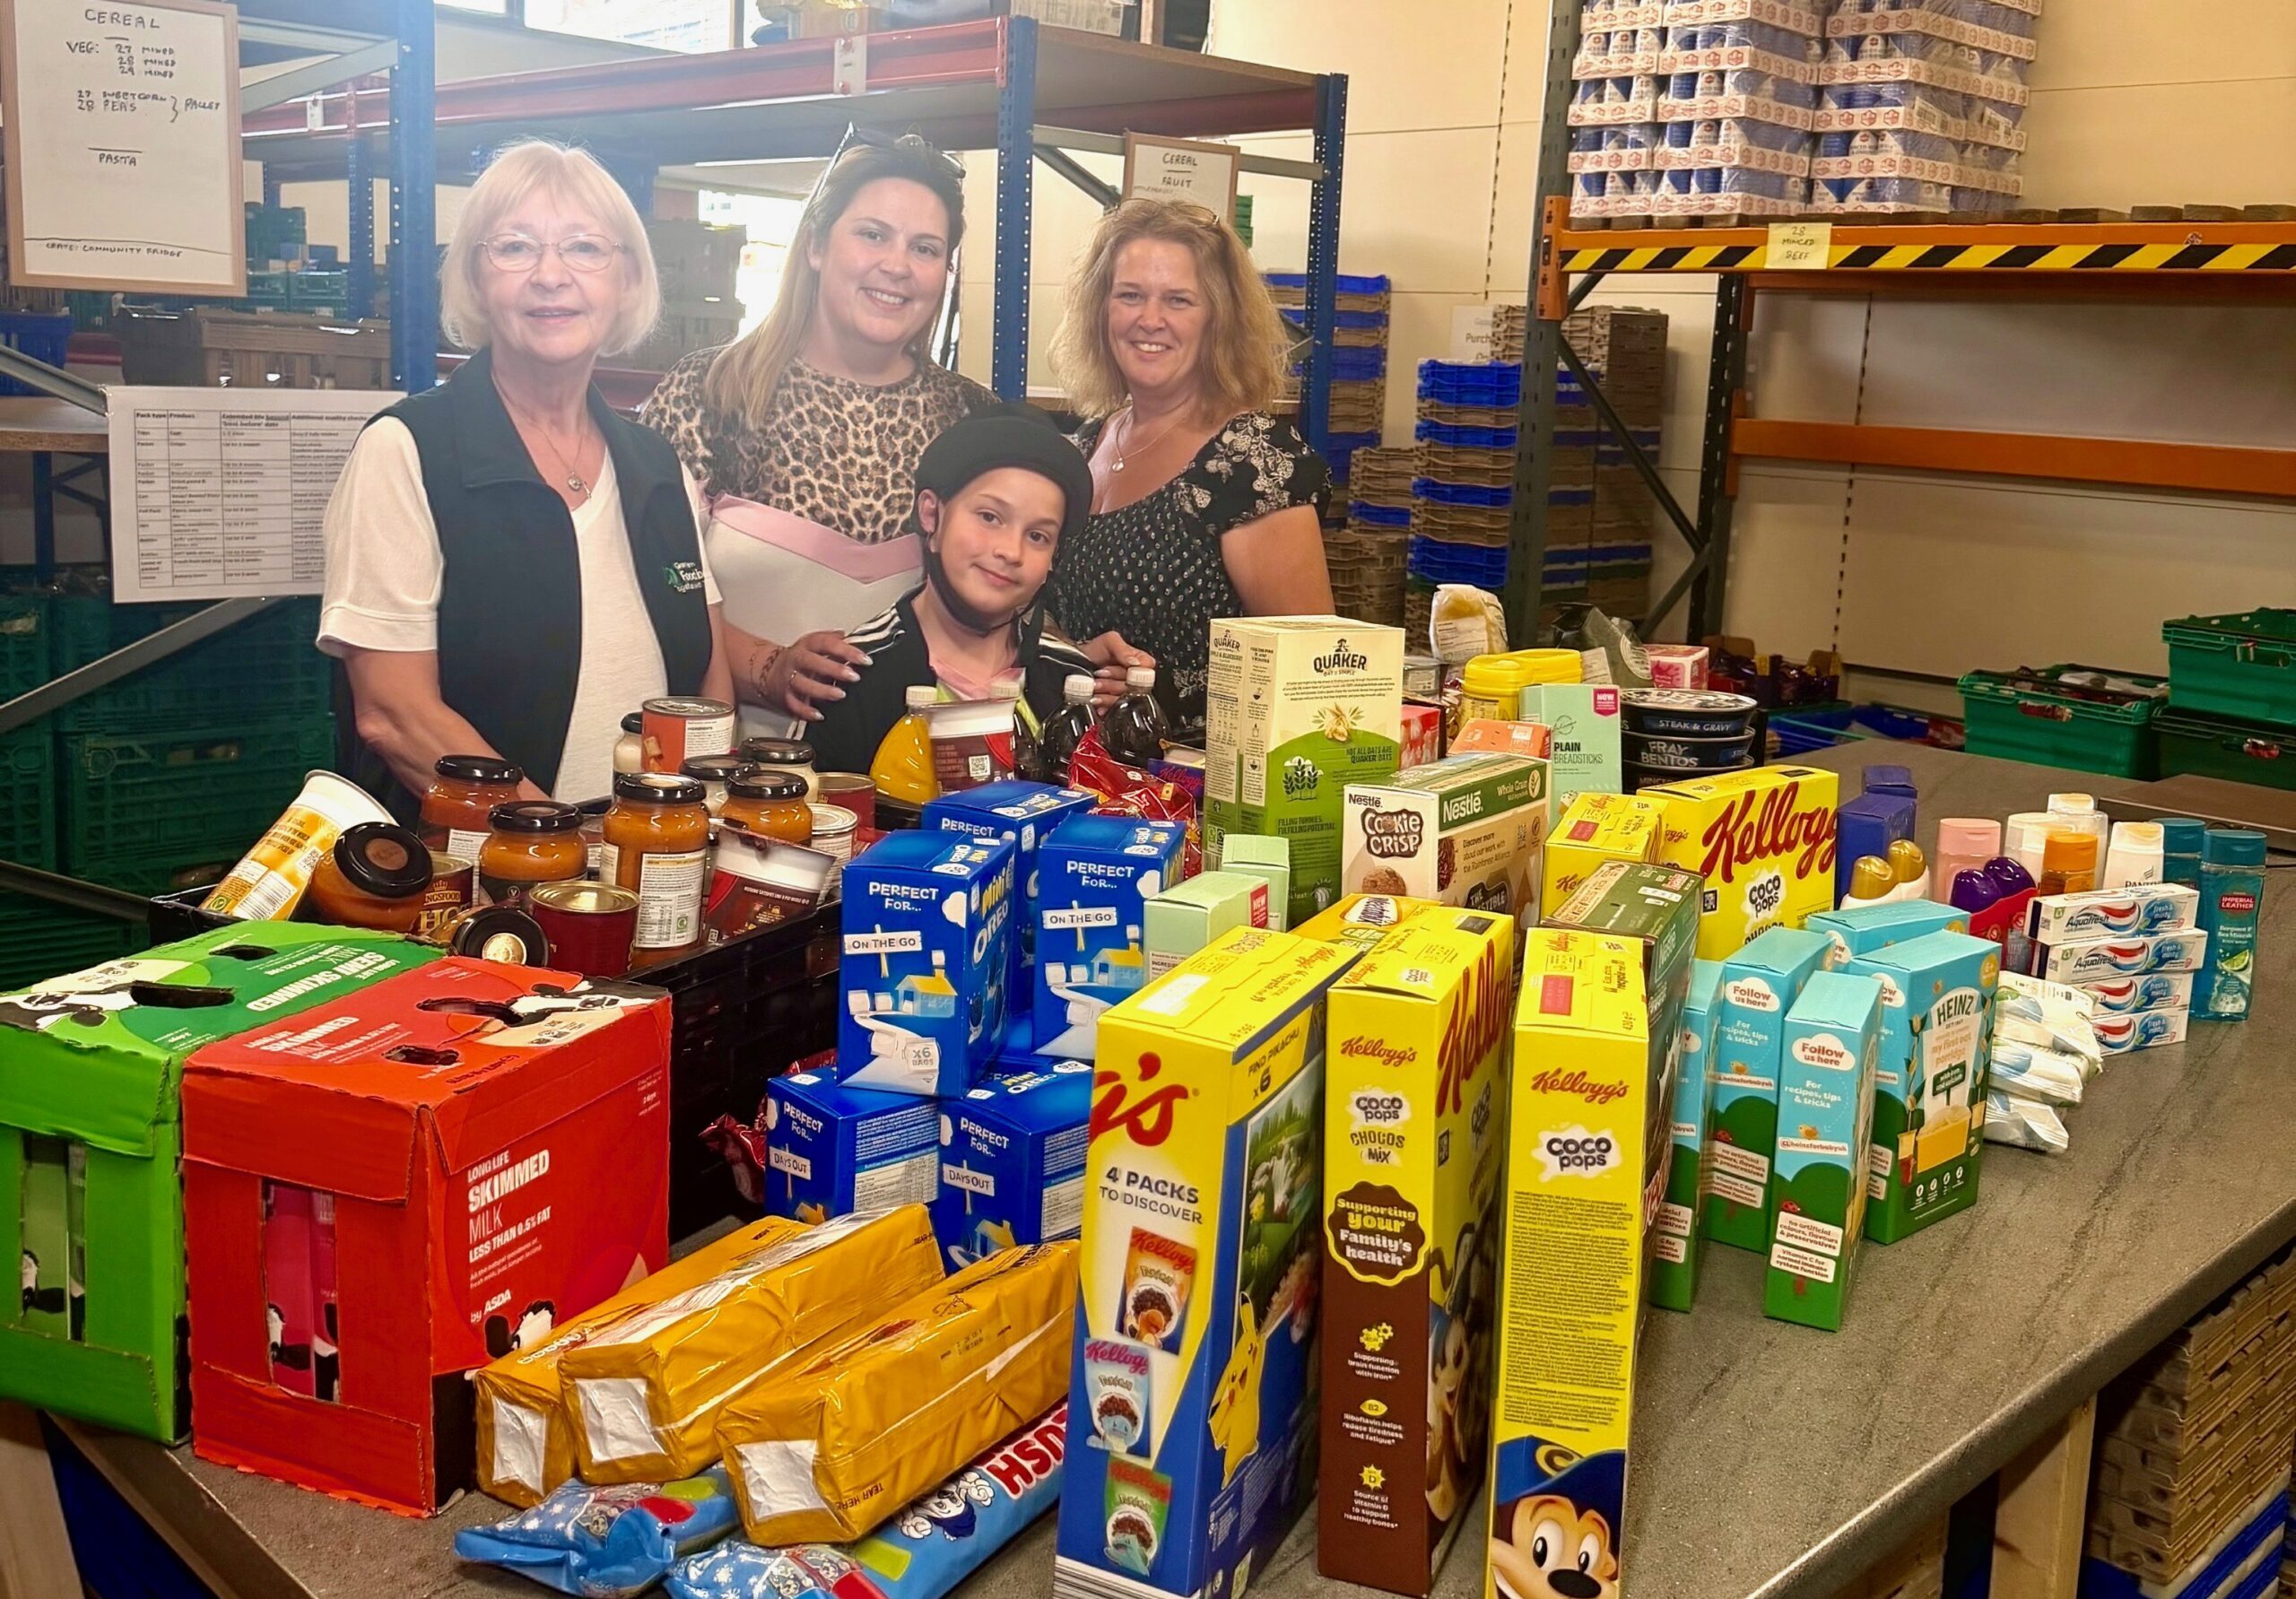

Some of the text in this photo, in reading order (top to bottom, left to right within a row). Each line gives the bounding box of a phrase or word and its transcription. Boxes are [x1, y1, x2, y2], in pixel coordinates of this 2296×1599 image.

[85, 9, 160, 29] CEREAL
[66, 41, 100, 54] VEG:
[115, 44, 132, 54] 27
[117, 56, 135, 65] 28
[77, 100, 94, 111] 28
[103, 100, 136, 111] PEAS
[99, 153, 136, 167] PASTA
[1162, 152, 1198, 167] CEREAL
[1161, 177, 1193, 187] FRUIT
[1791, 226, 1805, 236] 28
[83, 245, 142, 254] COMMUNITY
[1781, 238, 1814, 246] MINCED
[1786, 250, 1810, 260] BEEF
[1213, 638, 1241, 652] QUAKER
[1313, 653, 1368, 673] QUAKER
[1658, 719, 1732, 732] STEAK GRAVY
[1553, 742, 1581, 752] PLAIN
[1648, 741, 1689, 756] FRAY
[1351, 754, 1377, 764] QUAKER
[1553, 752, 1604, 765] BREADSTICKS
[1640, 752, 1700, 767] BENTOS
[1497, 783, 1514, 797] Whole
[941, 817, 995, 839] PERFECT
[1463, 832, 1495, 848] Discover more
[1066, 860, 1135, 879] PERFECT
[868, 881, 940, 900] PERFECT
[1252, 894, 1266, 910] NEW
[2222, 896, 2254, 904] IMPERIAL
[2222, 902, 2254, 910] LEATHER
[2152, 904, 2168, 913] fresh
[2153, 911, 2170, 920] minty
[1049, 912, 1112, 925] ON THE GO
[2066, 915, 2109, 929] Aquafresh
[973, 901, 1009, 963] OREO
[852, 936, 916, 950] ON THE GO
[2161, 945, 2176, 954] fresh
[2074, 953, 2118, 969] Aquafresh
[2161, 952, 2179, 960] minty
[246, 952, 386, 1012] SEMI SKIMMED
[1733, 986, 1770, 1001] Follow
[1735, 995, 1767, 1008] us here
[1936, 994, 1975, 1026] HEINZ
[1736, 1020, 1751, 1028] For
[258, 1016, 361, 1052] SKIMMED
[1735, 1036, 1758, 1047] tricks
[1752, 1030, 1768, 1041] tips
[1943, 1036, 1959, 1048] first
[911, 1047, 931, 1058] x6
[1248, 1028, 1300, 1077] FIND PIKACHU
[1340, 1036, 1418, 1067] Kellogg's
[1802, 1042, 1844, 1058] Follow
[1935, 1047, 1967, 1068] porridge
[912, 1057, 935, 1066] BAGS
[1804, 1054, 1840, 1066] us here
[1006, 1073, 1057, 1095] OREO
[1531, 1067, 1629, 1105] Kellogg's
[1805, 1080, 1822, 1090] For
[1785, 1086, 1841, 1102] recipes, tips
[1803, 1096, 1831, 1108] tricks
[783, 1100, 823, 1134] PERFECT
[960, 1117, 1010, 1150] PERFECT
[1350, 1130, 1405, 1148] CHOCOS
[467, 1150, 509, 1184] LONG LIFE
[793, 1159, 807, 1173] OUT
[468, 1148, 550, 1213] SKIMMED
[971, 1176, 991, 1191] OUT
[1106, 1167, 1199, 1204] 4 PACKS
[1099, 1186, 1204, 1225] TO DISCOVER
[1336, 1198, 1416, 1221] Supporting
[469, 1202, 503, 1245] MILK
[1347, 1212, 1405, 1233] your
[1799, 1221, 1831, 1236] artificial
[469, 1205, 552, 1264] LESS THAN 0.5% FAT
[1340, 1229, 1412, 1252] Family's
[1786, 1231, 1837, 1250] preservatives
[1808, 1230, 1839, 1244] flavours
[1777, 1255, 1799, 1266] normal
[1782, 1249, 1808, 1261] Vitamin
[1776, 1259, 1829, 1279] system function
[470, 1289, 512, 1324] by ASDA
[1353, 1351, 1395, 1366] Supporting
[1347, 1359, 1400, 1375] brain function
[1355, 1369, 1371, 1377] with
[1344, 1412, 1403, 1430] Riboflavin helps
[1342, 1421, 1404, 1438] reduce tiredness
[1350, 1430, 1364, 1439] and
[988, 1407, 1068, 1496] USH
[834, 1481, 884, 1512] TEAR HERE
[1353, 1490, 1379, 1502] Source
[1344, 1512, 1371, 1525] healthy
[1361, 1508, 1390, 1520] support
